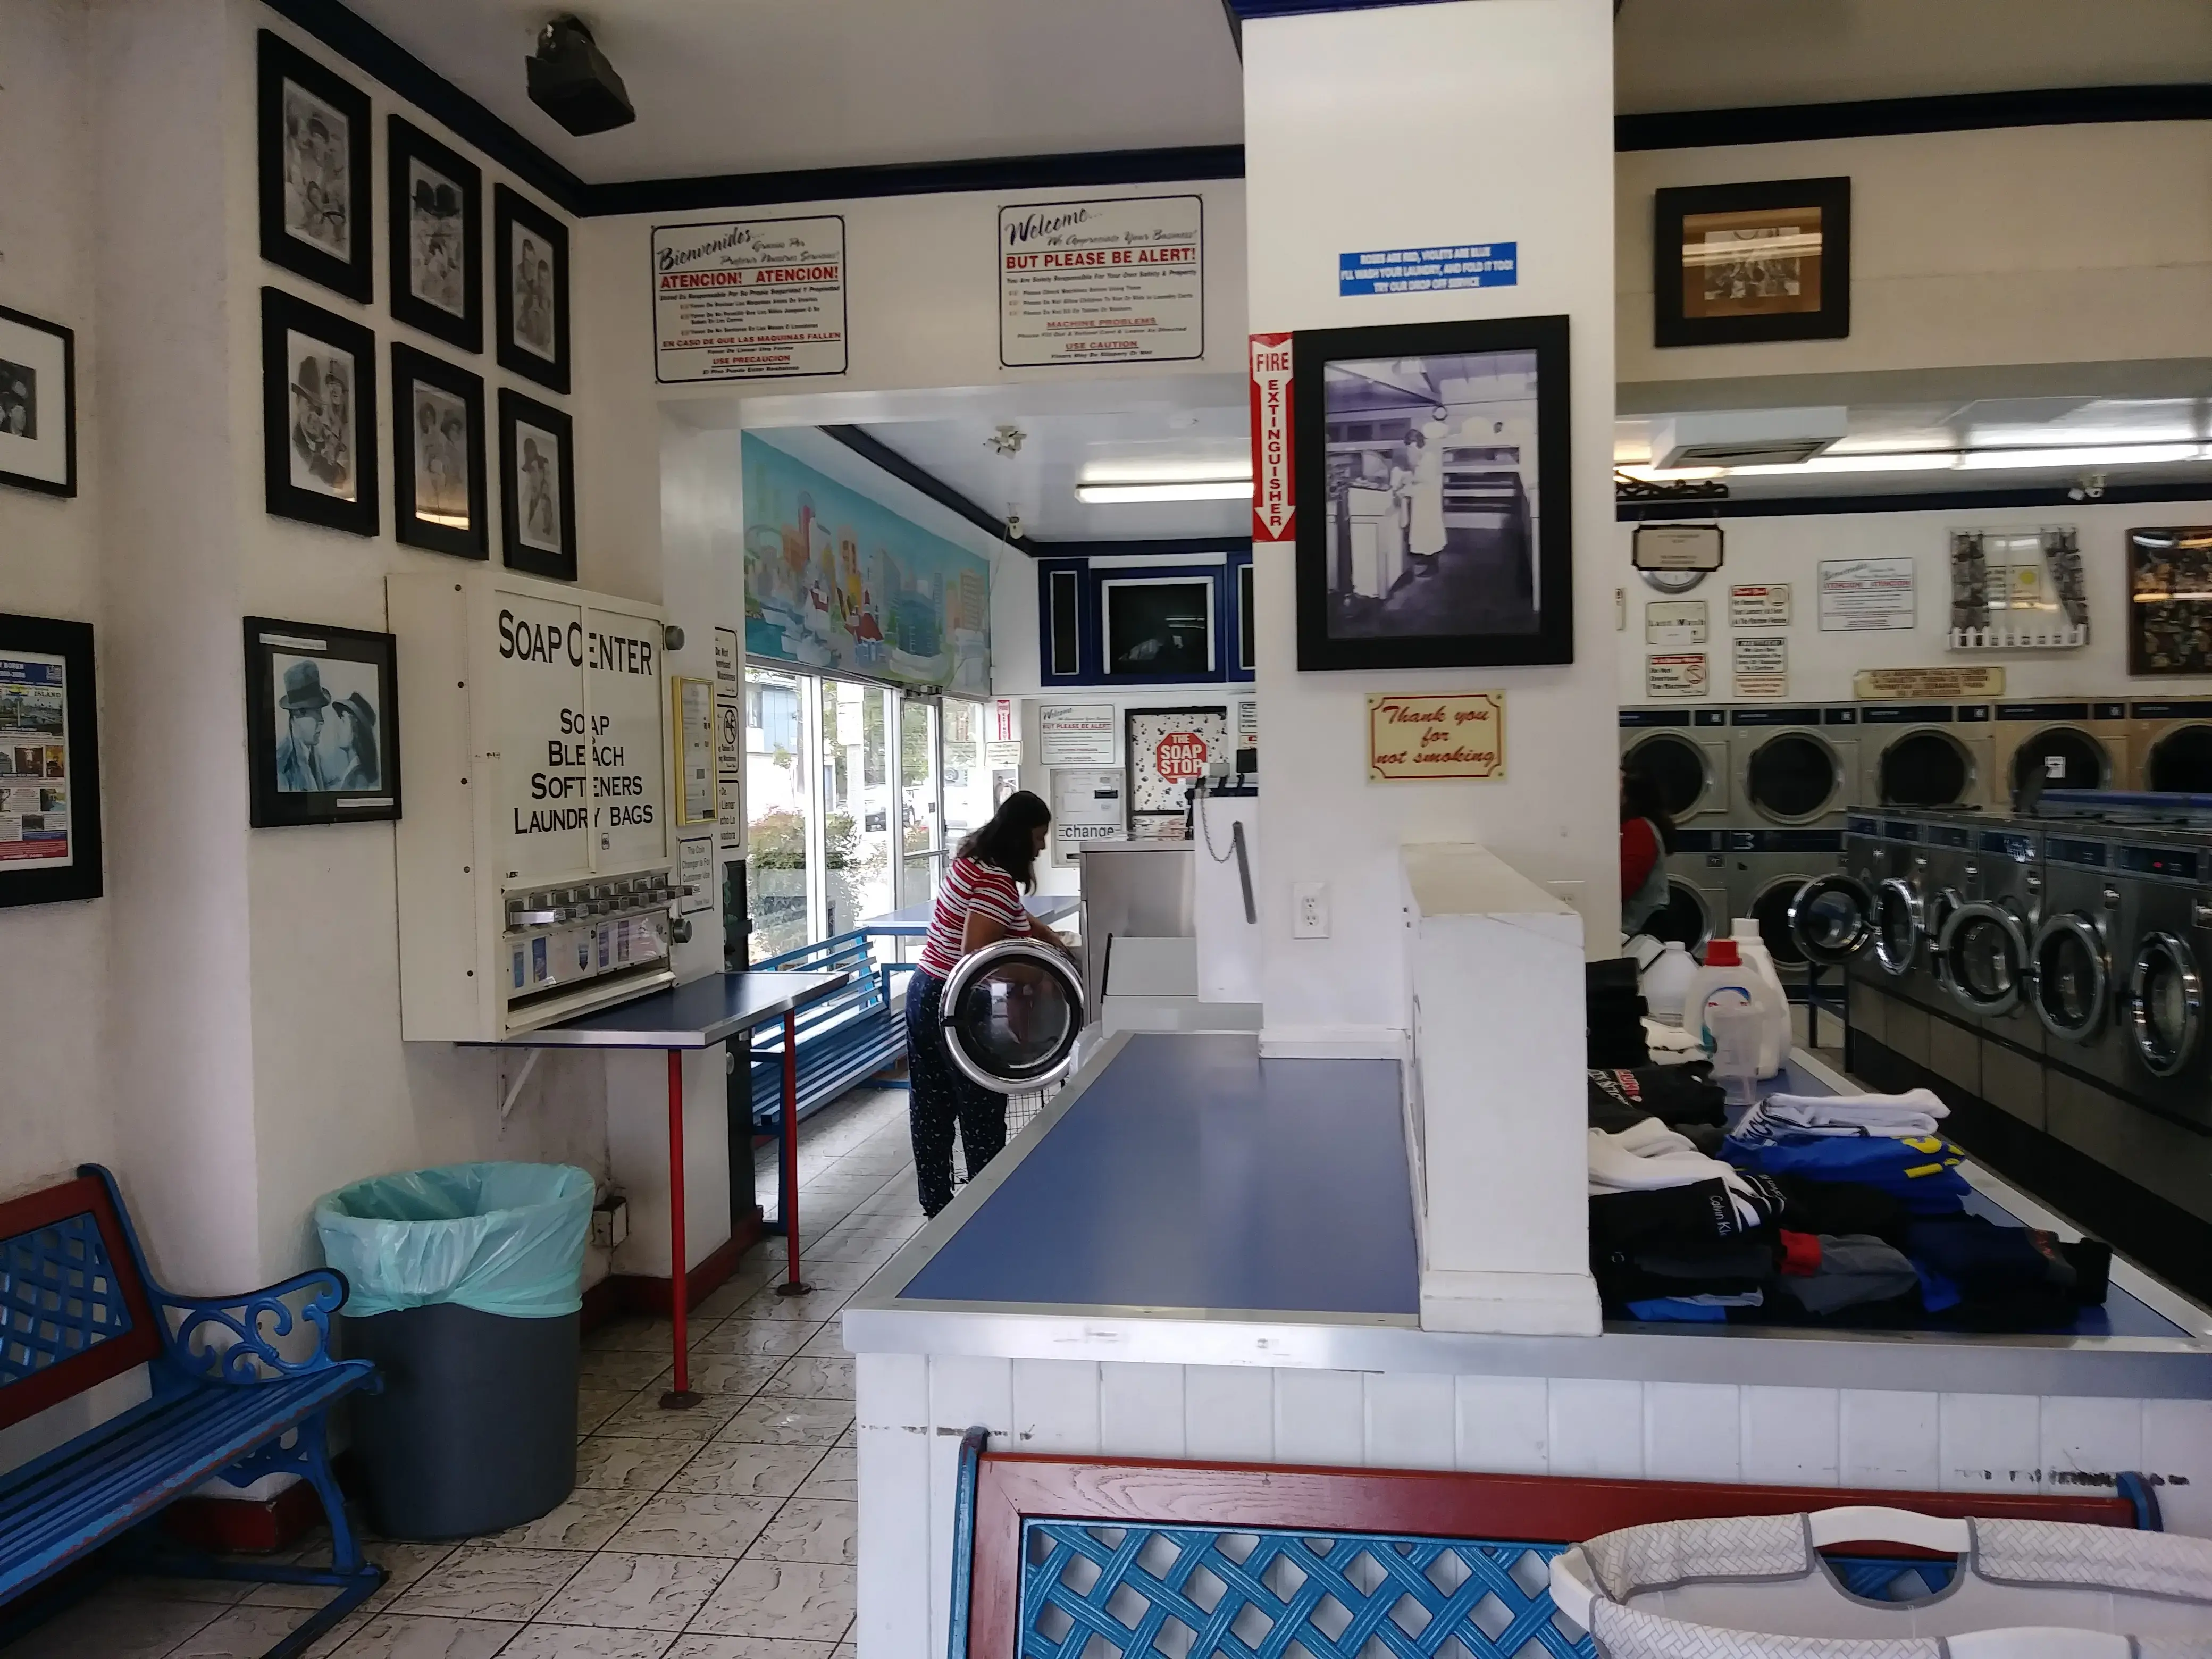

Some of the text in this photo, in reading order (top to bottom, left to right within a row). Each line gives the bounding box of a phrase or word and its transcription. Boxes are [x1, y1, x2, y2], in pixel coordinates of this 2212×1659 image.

[1006, 248, 1195, 269] BUT PLEASE BE ALERT!
[660, 266, 839, 289] ATENCION! ATENCION!
[757, 333, 805, 342] MAQUINAS
[732, 355, 791, 364] PRECAUCION
[1256, 352, 1289, 372] FIRE
[1267, 380, 1283, 526] EXTINGUISHER
[499, 609, 653, 675] SOAP CENTER
[560, 708, 610, 736] SOAP
[1382, 706, 1489, 726] Thank you
[1171, 734, 1191, 744] THE
[1420, 727, 1450, 748] for
[548, 740, 624, 766] BLEACH
[1160, 744, 1202, 760] SOAP
[1376, 745, 1495, 767] not smoking
[1160, 759, 1203, 774] STOP
[531, 773, 643, 800] SOFTENERS
[514, 804, 653, 834] LAUNDRY BAGS
[1066, 824, 1115, 839] change
[1709, 1195, 1725, 1220] Calvin
